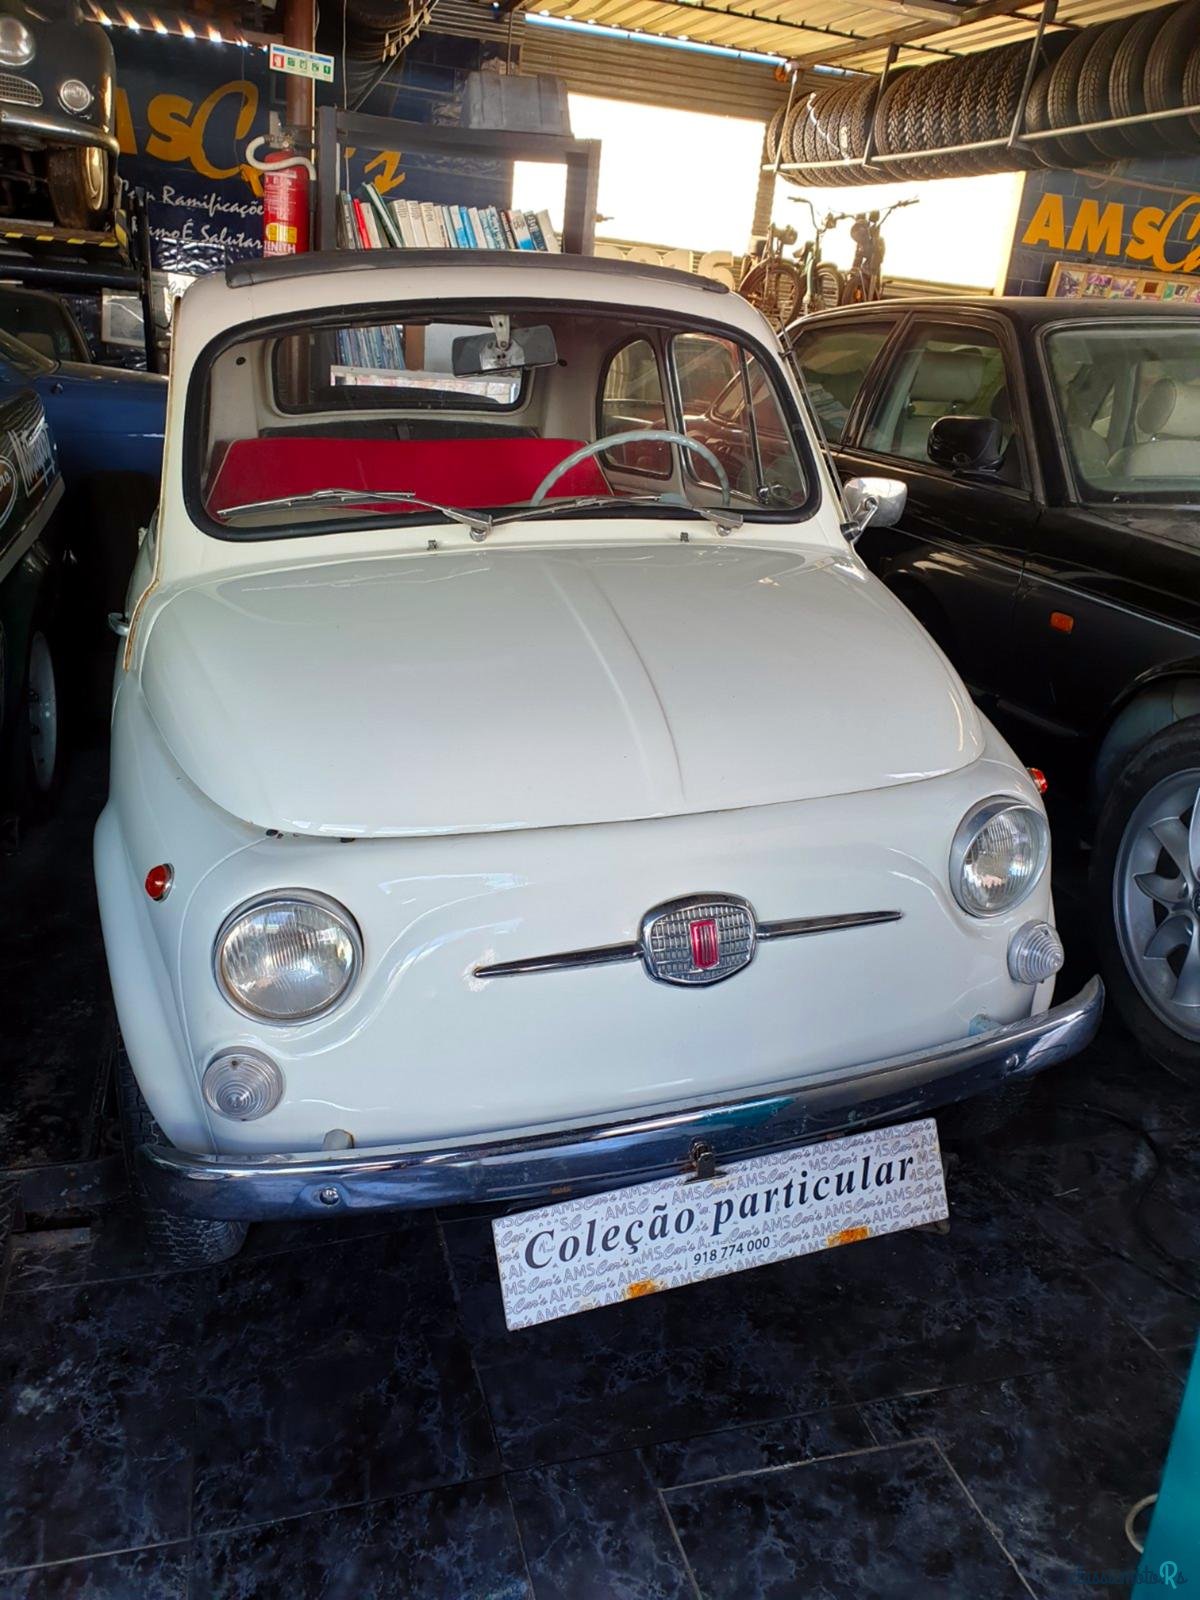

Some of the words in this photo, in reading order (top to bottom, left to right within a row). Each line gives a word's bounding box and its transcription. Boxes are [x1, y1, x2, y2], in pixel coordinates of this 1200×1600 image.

[162, 185, 264, 218] Ramificaçõe
[201, 224, 263, 249] Salutar
[525, 1203, 695, 1269] Coleção
[711, 1156, 913, 1236] particular
[693, 1249, 717, 1265] 918
[721, 1242, 743, 1260] 774
[747, 1236, 770, 1252] 000
